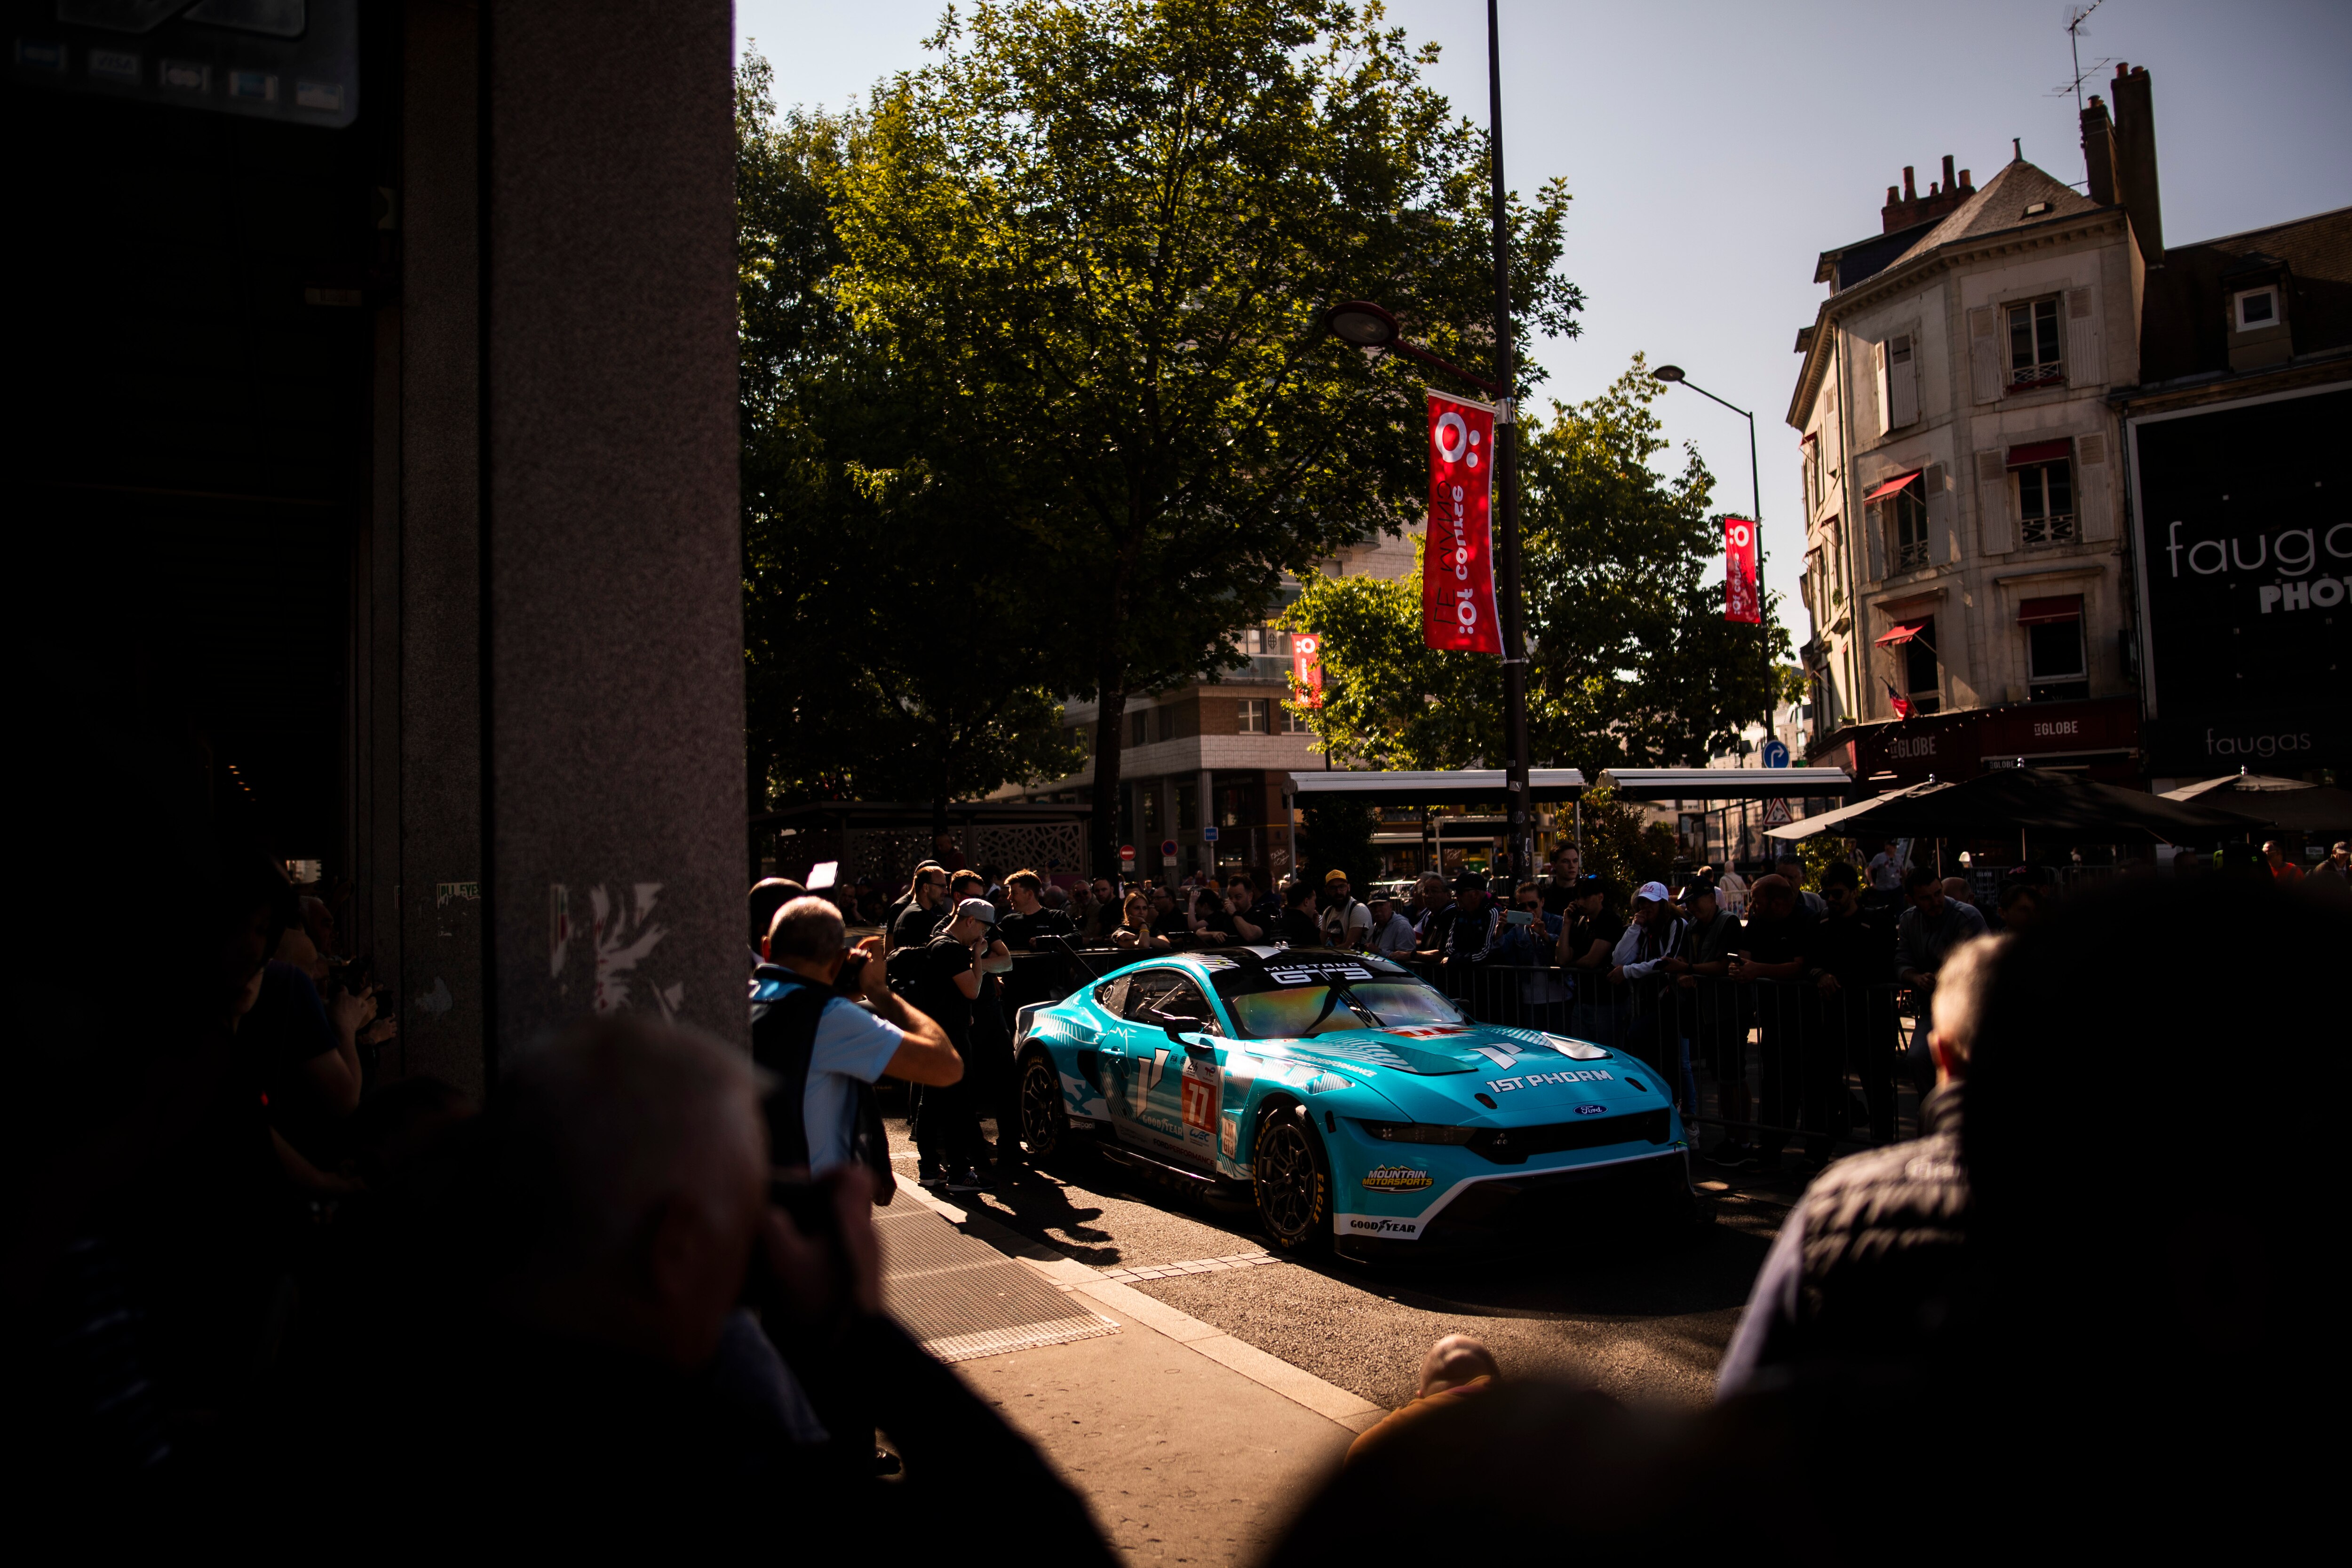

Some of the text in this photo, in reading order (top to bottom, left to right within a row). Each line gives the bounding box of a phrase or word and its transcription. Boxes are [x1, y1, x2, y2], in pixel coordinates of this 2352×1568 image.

[2042, 720, 2078, 736] GLOBE
[1898, 736, 1937, 759] GLOBE
[2205, 728, 2312, 758] faugas
[1263, 962, 1361, 972] MUSTANG
[1271, 967, 1373, 984] GT3
[1486, 1070, 1614, 1093] 1ST PHORM
[1189, 1083, 1209, 1127] 77
[1581, 1106, 1602, 1114] Ford
[1081, 1121, 1095, 1130] paoli
[1224, 1138, 1233, 1155] GT3
[1169, 1144, 1214, 1167] PERFORMANCE
[1368, 1170, 1427, 1179] MOUNTAIN
[1312, 1172, 1324, 1224] EAGLE
